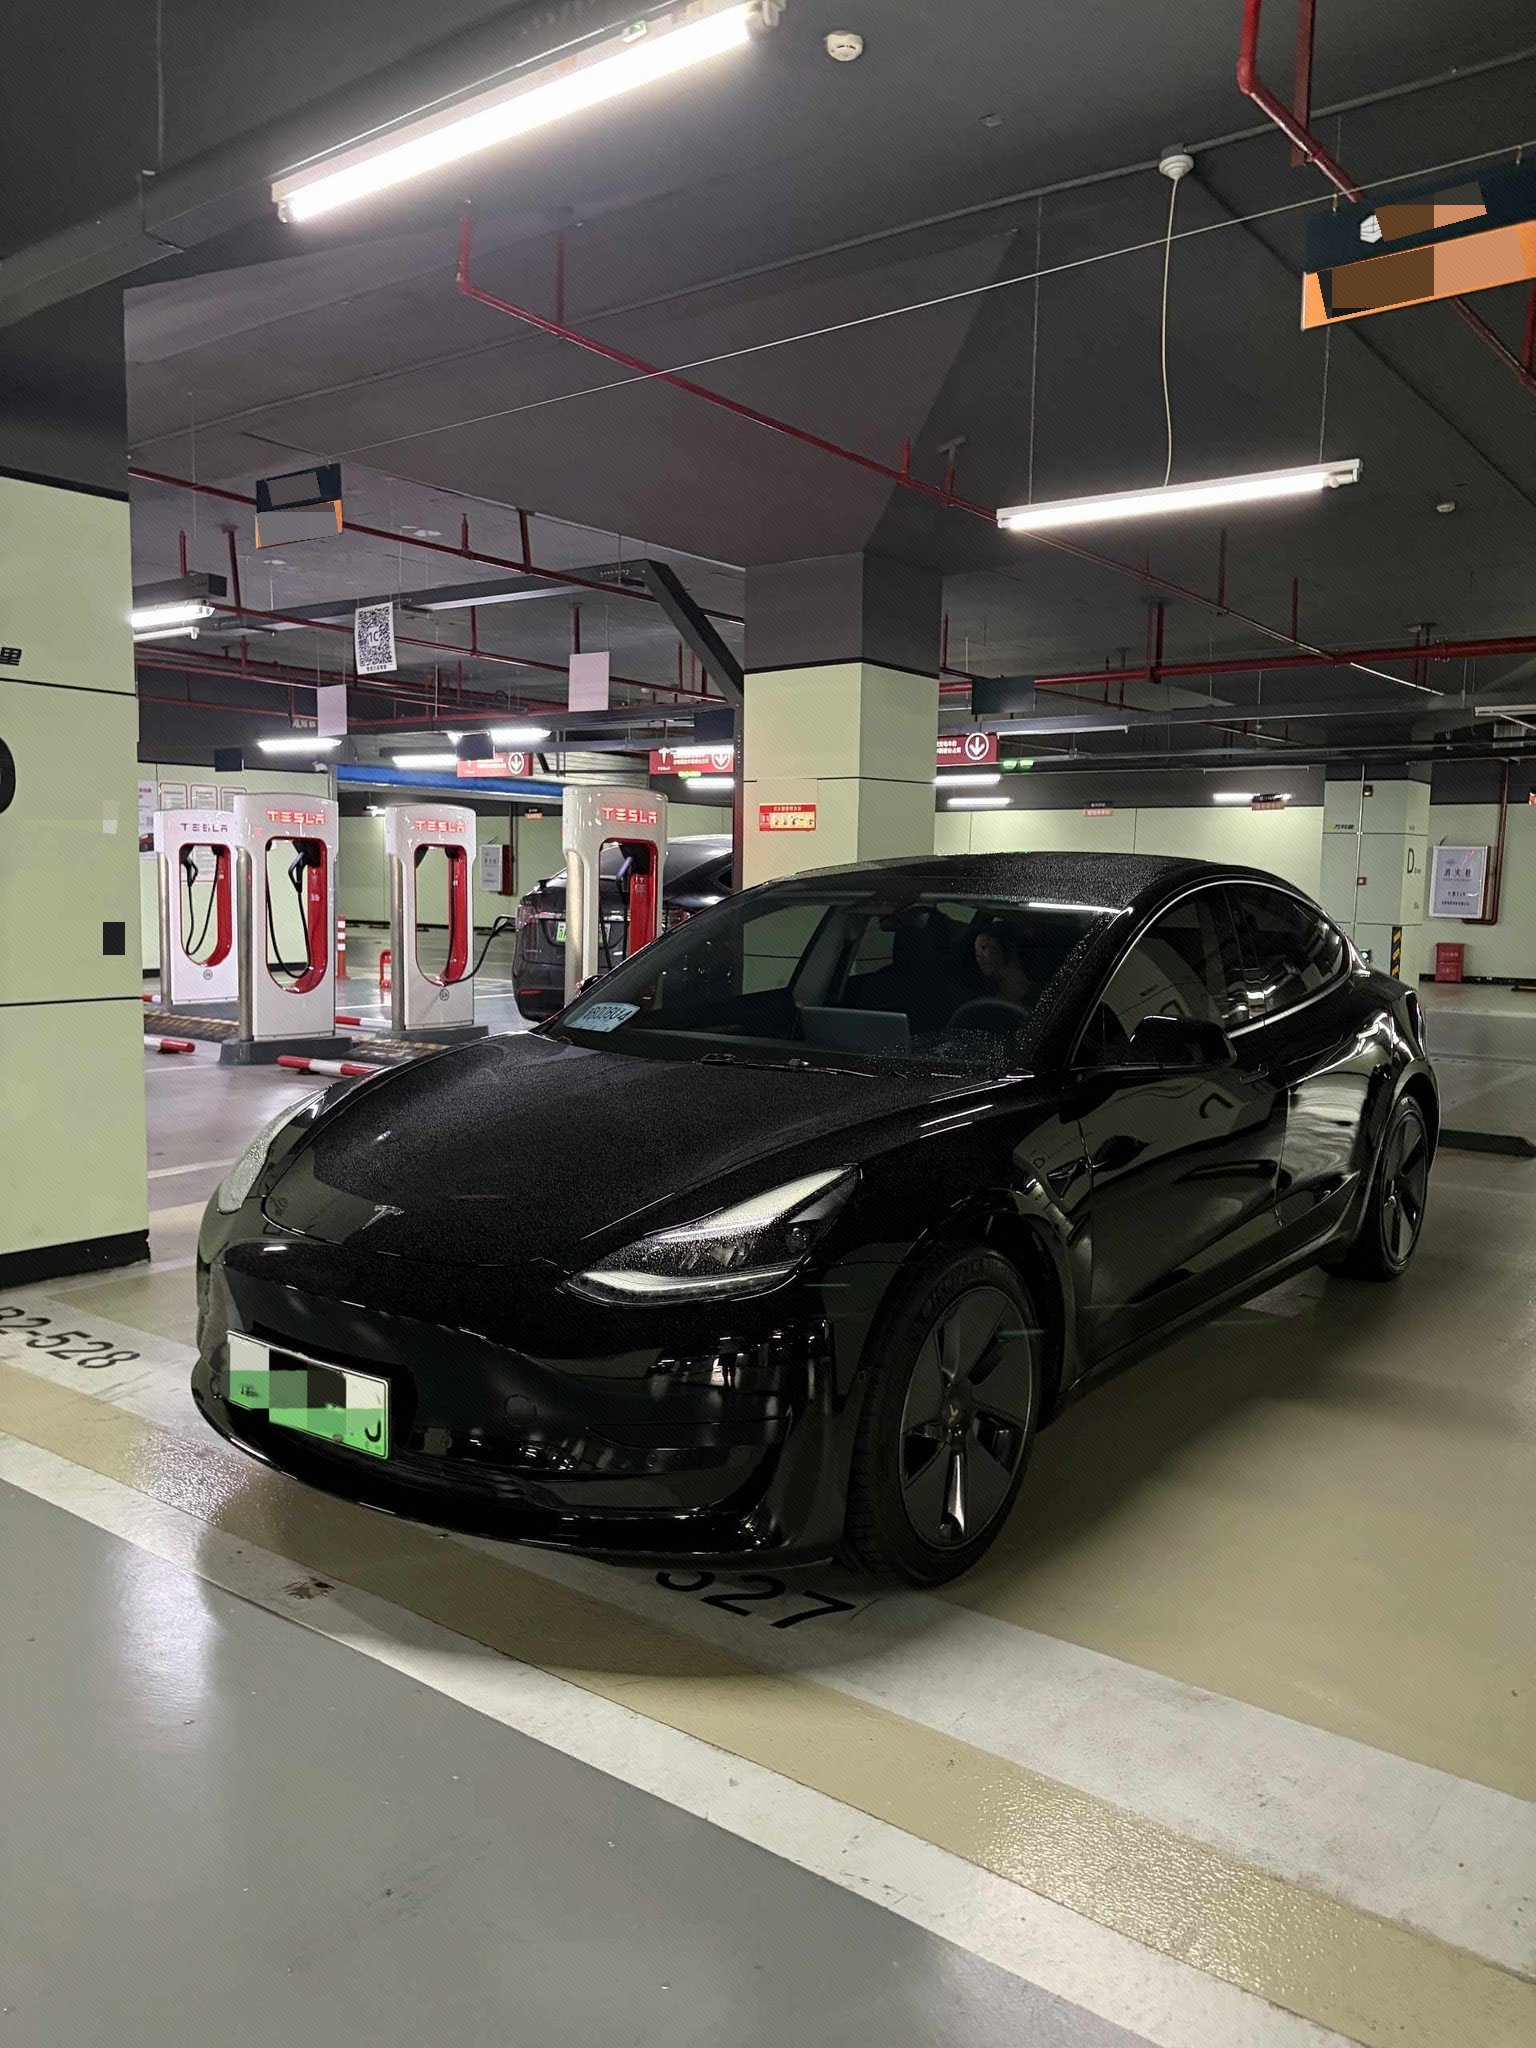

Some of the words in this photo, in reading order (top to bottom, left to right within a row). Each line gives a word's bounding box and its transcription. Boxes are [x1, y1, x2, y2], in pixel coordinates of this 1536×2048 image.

[266, 810, 325, 825] TESLA
[602, 807, 658, 824] TESLA
[181, 822, 228, 832] TESLA
[416, 820, 466, 833] TESLA
